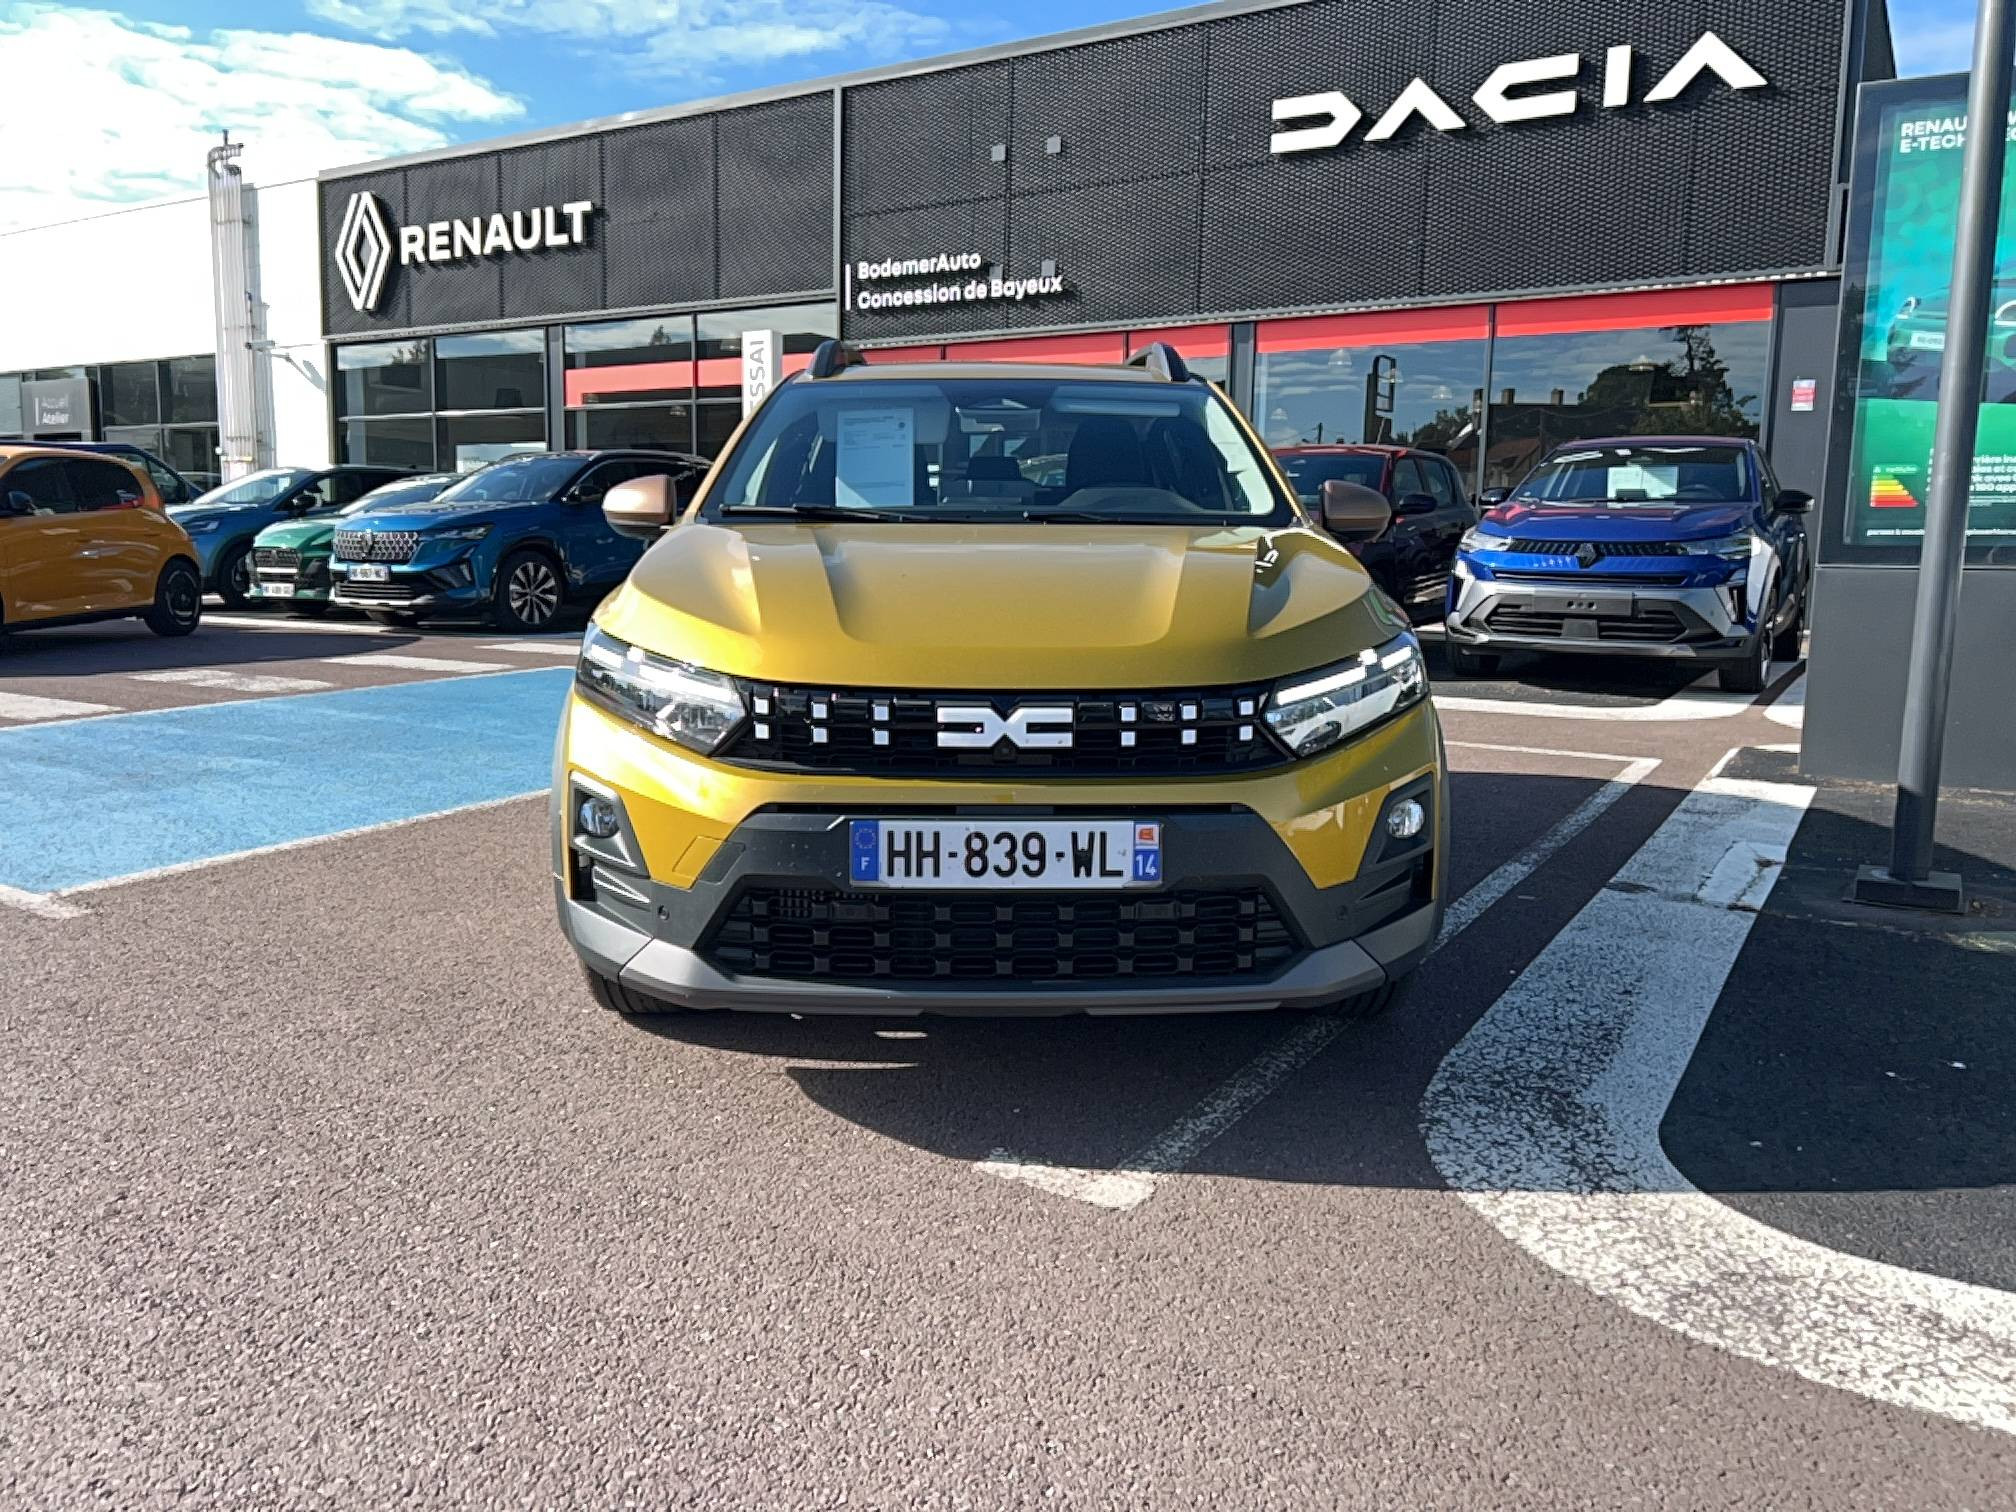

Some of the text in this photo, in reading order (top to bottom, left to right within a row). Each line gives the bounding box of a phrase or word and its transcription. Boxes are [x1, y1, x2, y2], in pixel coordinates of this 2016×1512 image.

[1270, 30, 1769, 154] DACIA
[1901, 115, 1968, 137] RENAU
[400, 200, 592, 266] RENAULT
[857, 252, 982, 280] BodemerAuto
[857, 274, 1064, 309] Concession de Bayeux
[749, 340, 766, 412] SSAI
[860, 857, 869, 870] F
[1135, 854, 1157, 877] 14
